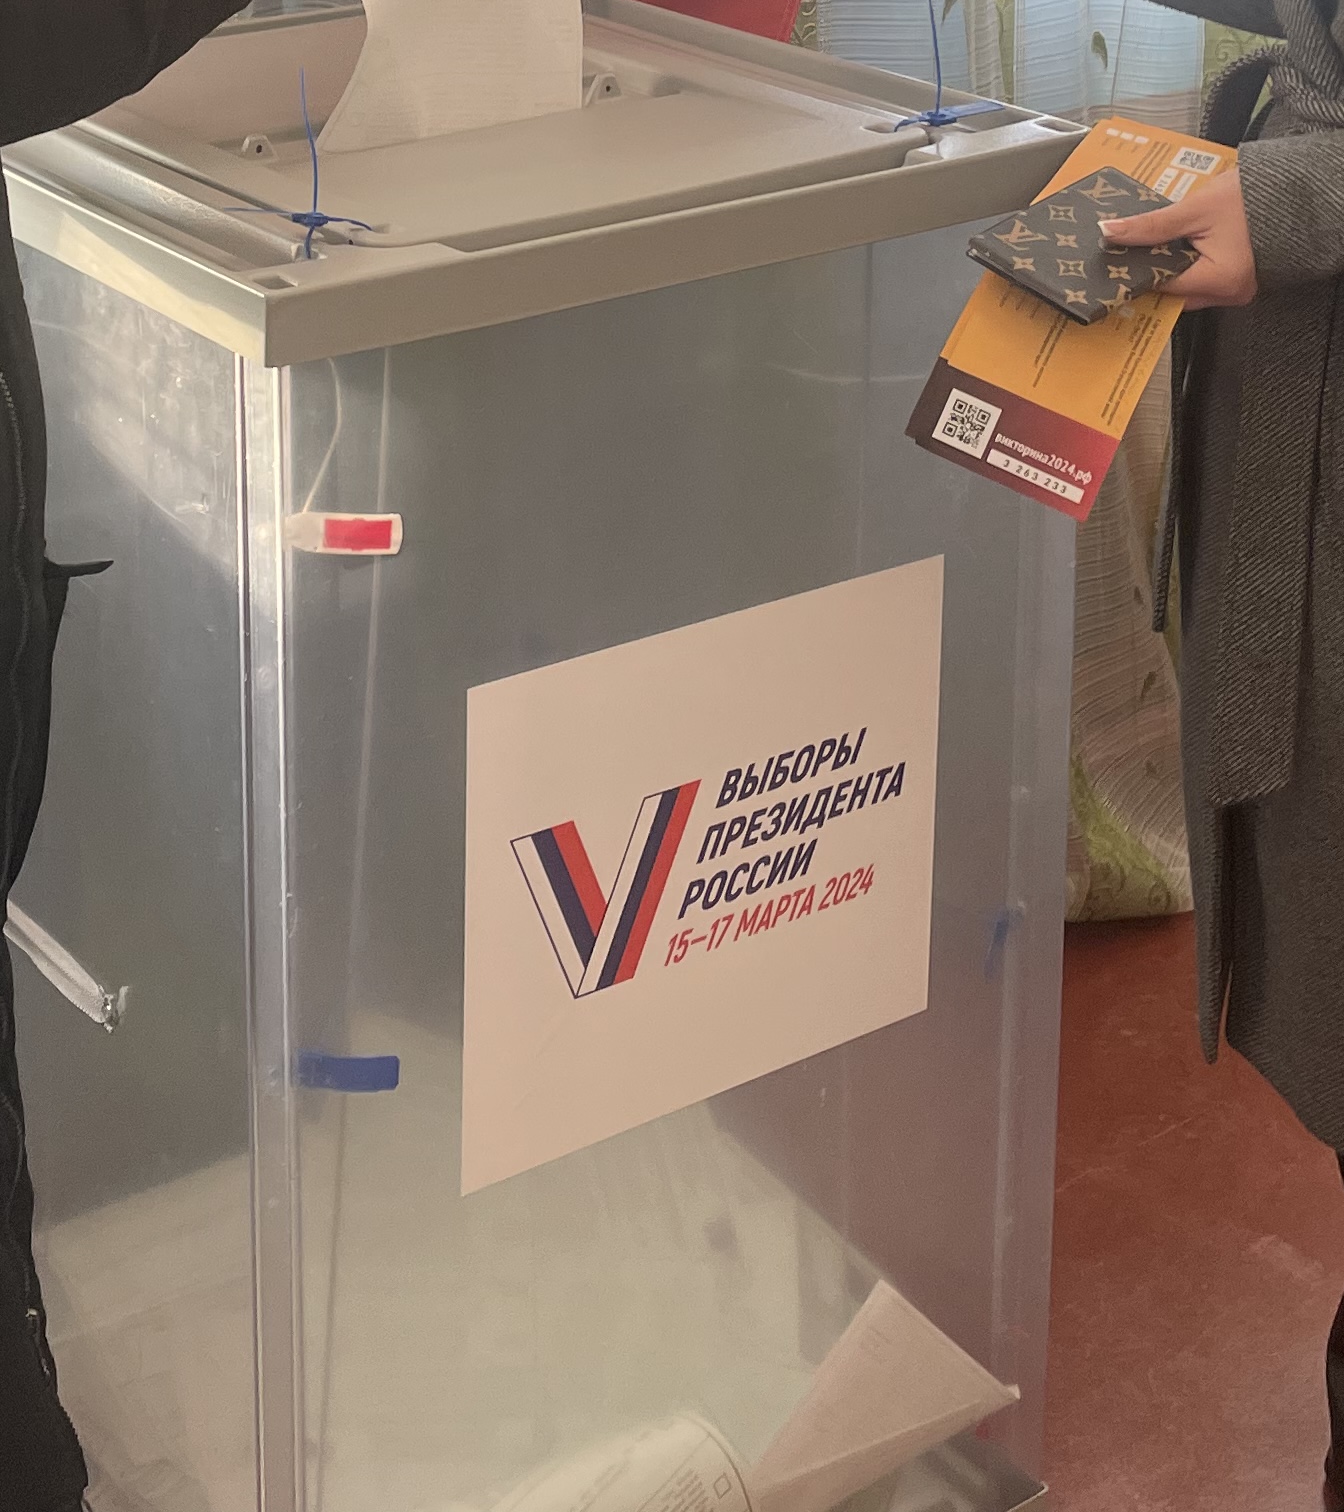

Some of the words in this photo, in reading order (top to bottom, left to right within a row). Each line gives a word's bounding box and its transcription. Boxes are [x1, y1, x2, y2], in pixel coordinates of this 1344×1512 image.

[994, 432, 1093, 486] викторина2024.рф
[1015, 465, 1039, 482] 263
[1043, 477, 1068, 495] 233
[715, 726, 868, 809] ВЫБОРЫ
[696, 761, 907, 865] ПРЕЗИДЕНТА
[677, 838, 819, 921] РОССИИ
[733, 884, 817, 943] МАРТА
[817, 863, 875, 912] 2024
